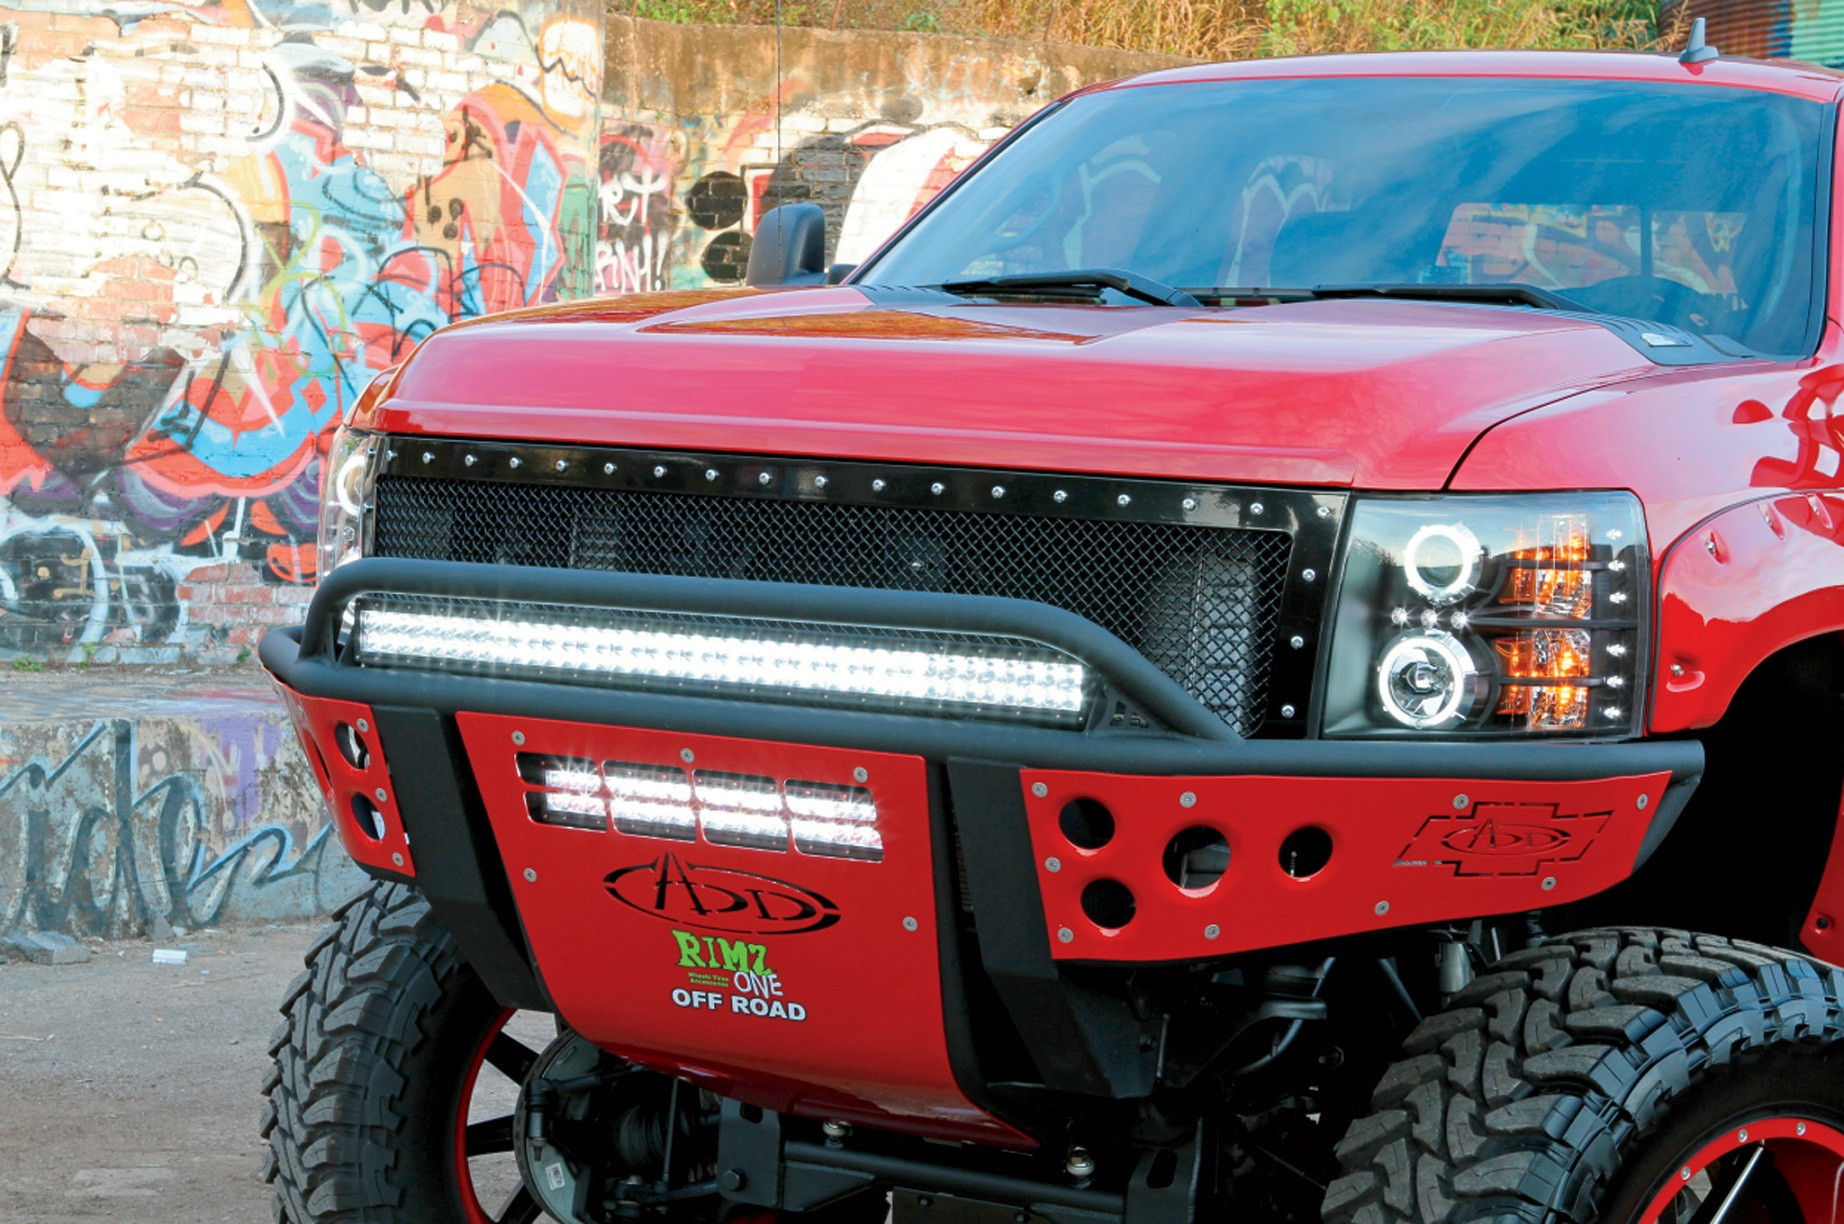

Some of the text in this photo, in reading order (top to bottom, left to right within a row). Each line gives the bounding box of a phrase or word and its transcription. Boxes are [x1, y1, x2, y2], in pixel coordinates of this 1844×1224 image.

[672, 929, 772, 976] RIMZ
[733, 969, 784, 999] ONE
[671, 988, 807, 1021] OFF ROAD
